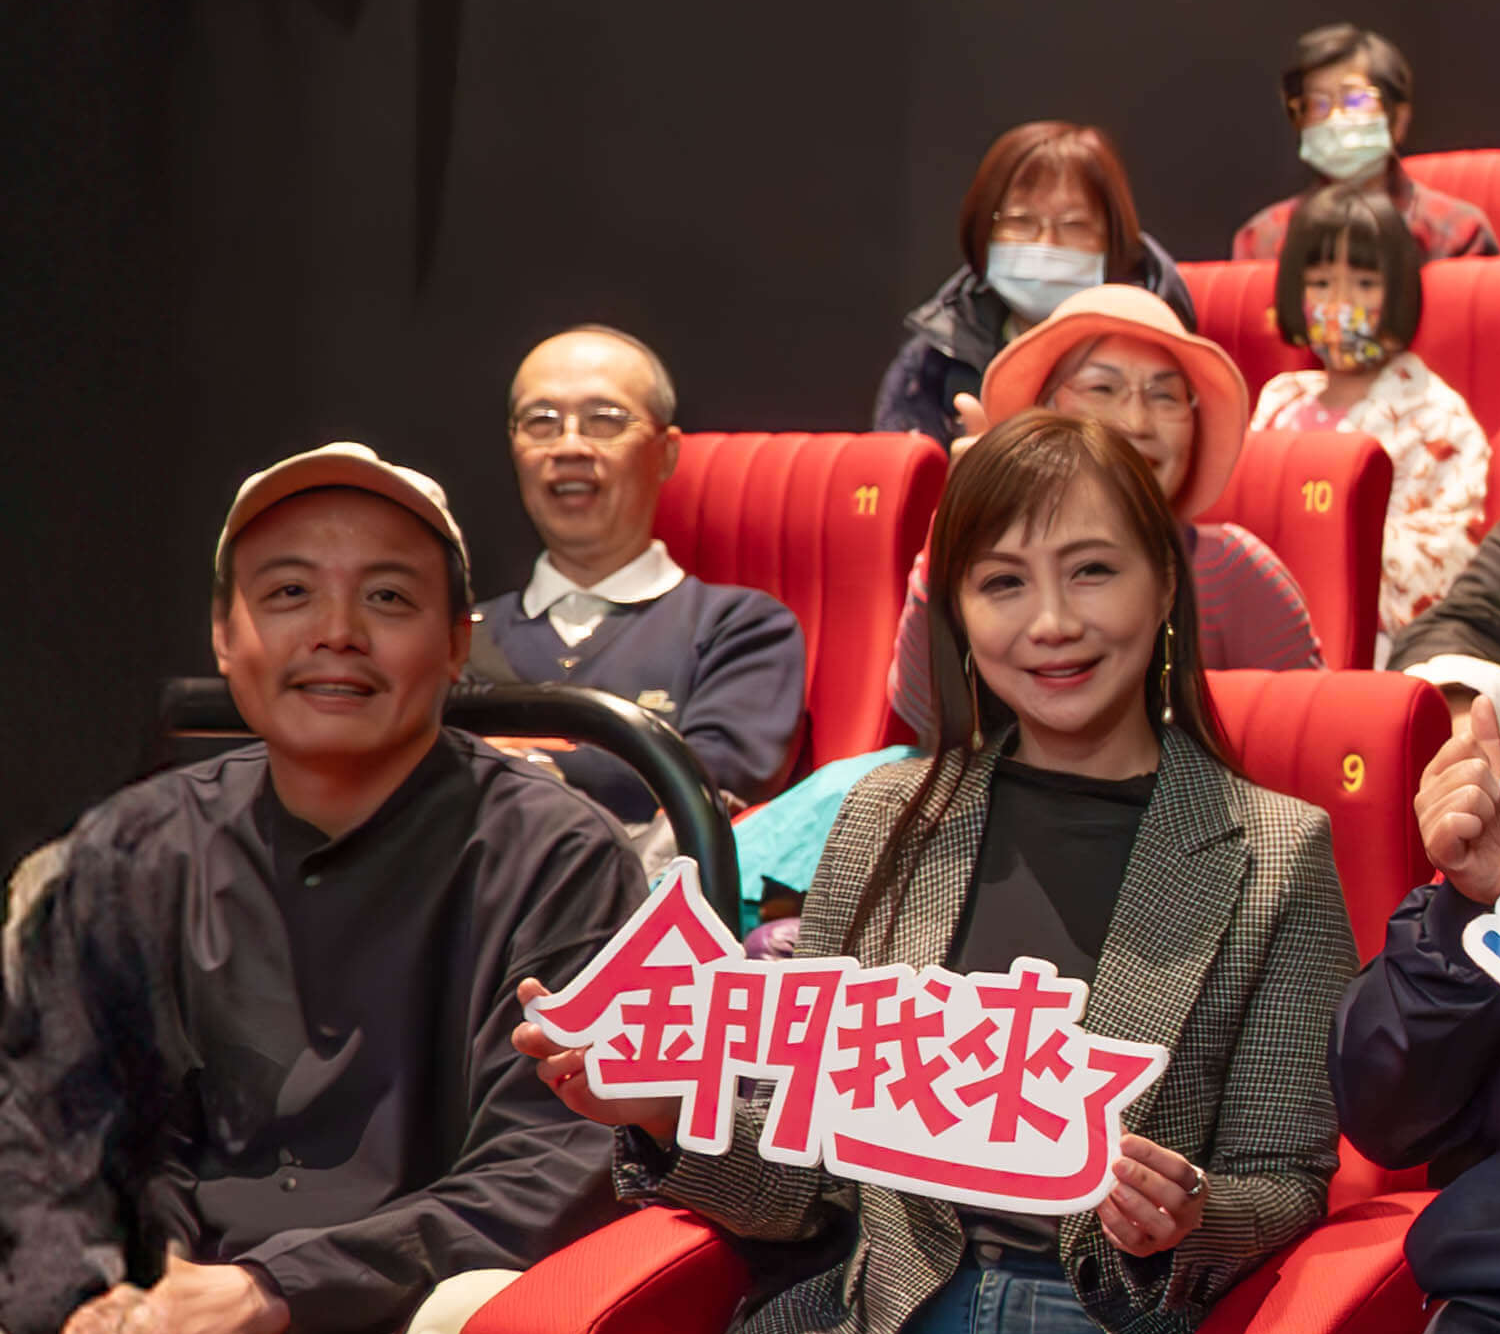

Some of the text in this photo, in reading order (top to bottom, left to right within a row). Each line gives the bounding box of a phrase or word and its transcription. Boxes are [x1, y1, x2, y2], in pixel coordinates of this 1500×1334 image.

[854, 484, 880, 515] 11
[1300, 480, 1331, 513] 10
[1342, 753, 1365, 793] 9
[540, 873, 1154, 1202] 金門我來了
